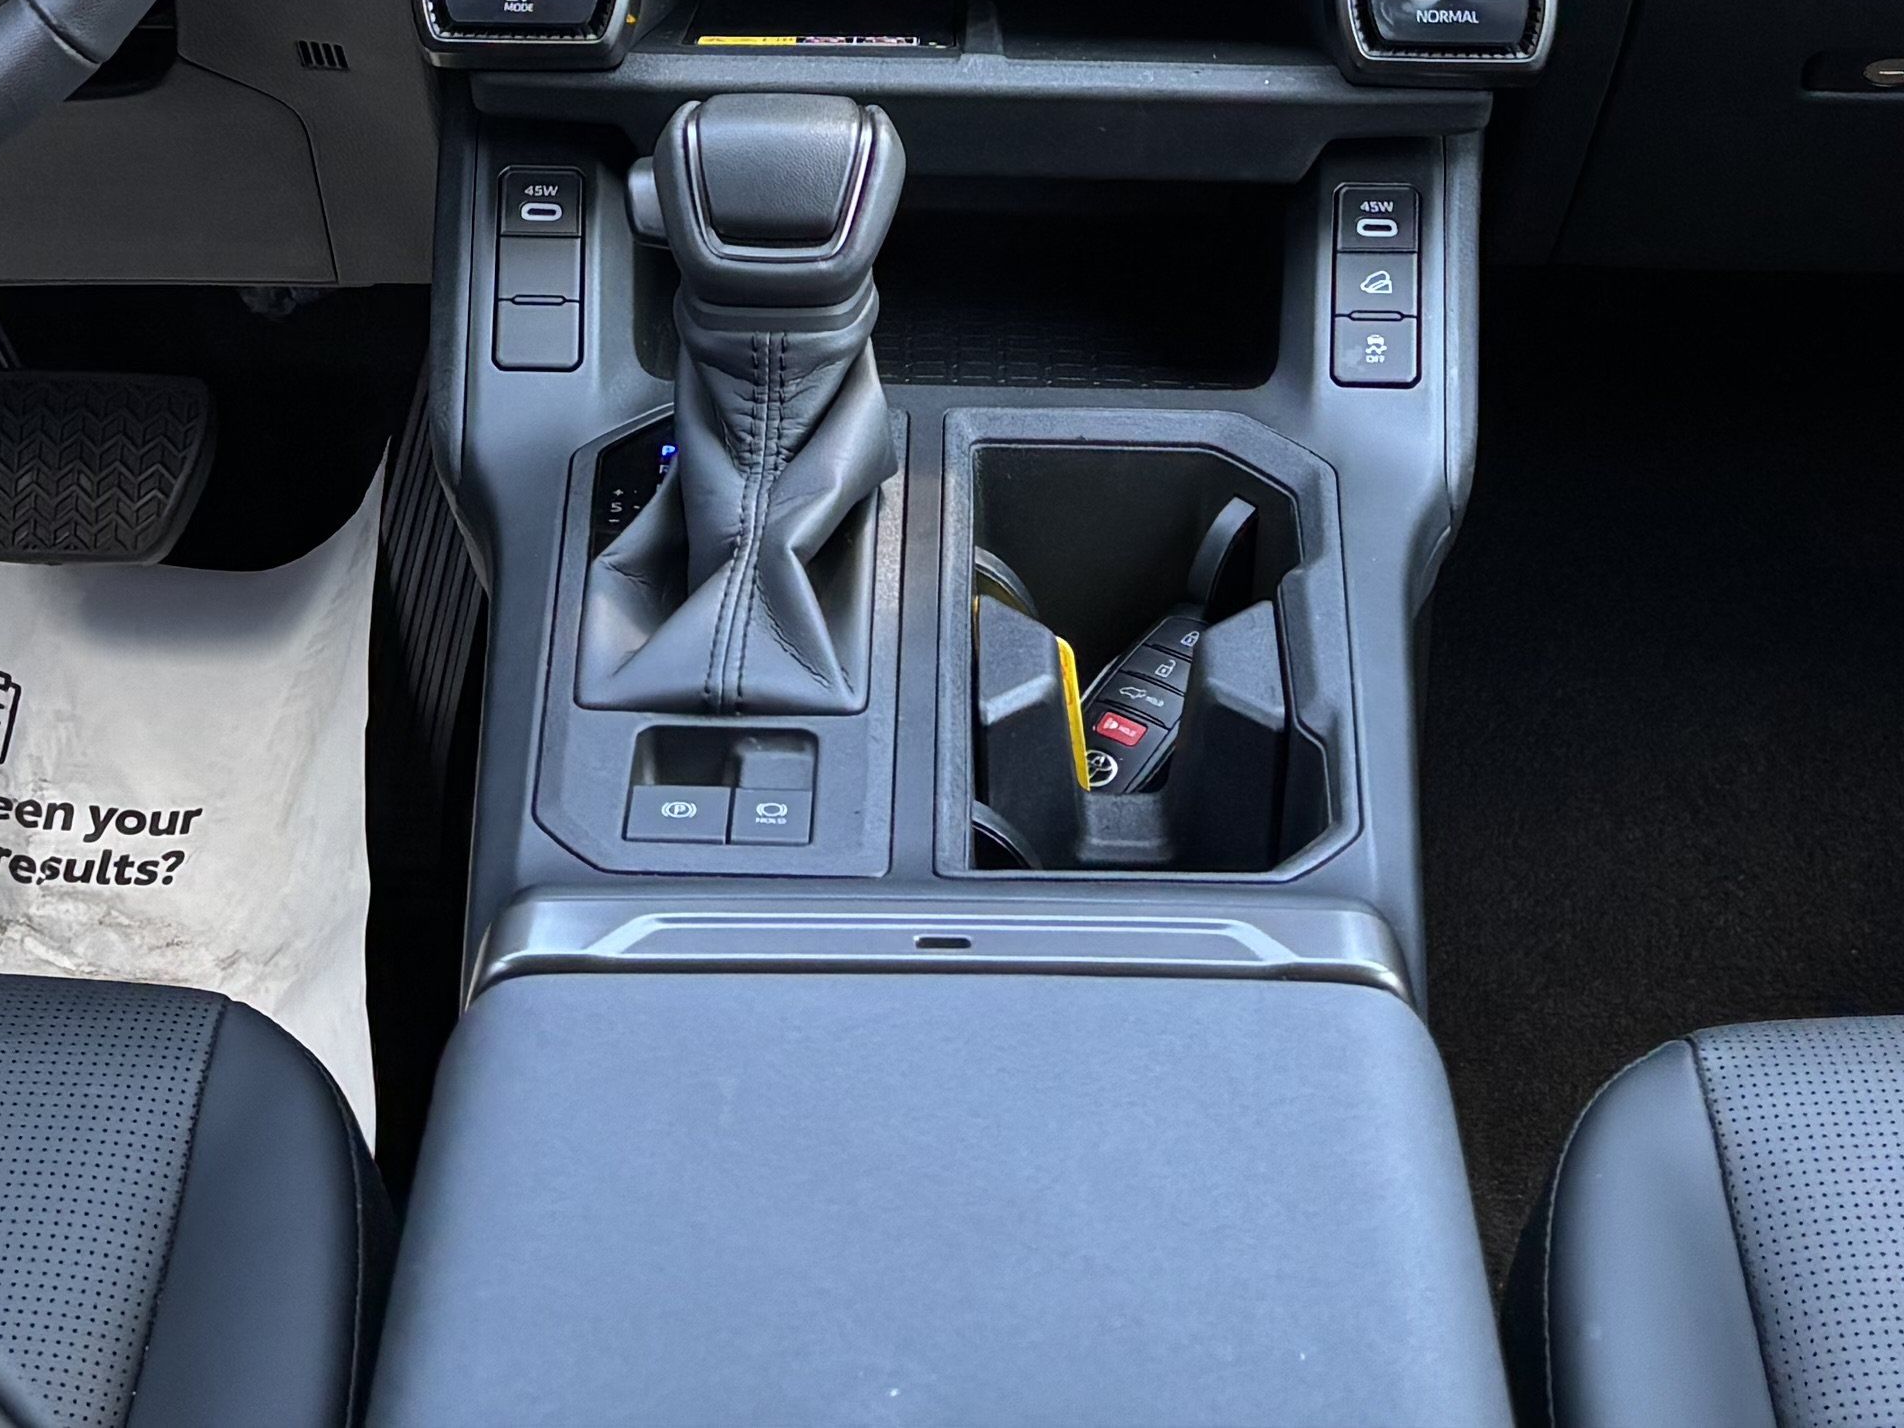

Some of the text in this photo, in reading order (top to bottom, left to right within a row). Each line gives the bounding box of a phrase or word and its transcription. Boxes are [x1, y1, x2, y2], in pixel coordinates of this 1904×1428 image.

[503, 1, 534, 14] MODE
[1415, 8, 1480, 25] NORMAL
[524, 184, 559, 197] 45W
[1359, 200, 1395, 214] 45W
[661, 444, 676, 456] P
[82, 802, 203, 843] your
